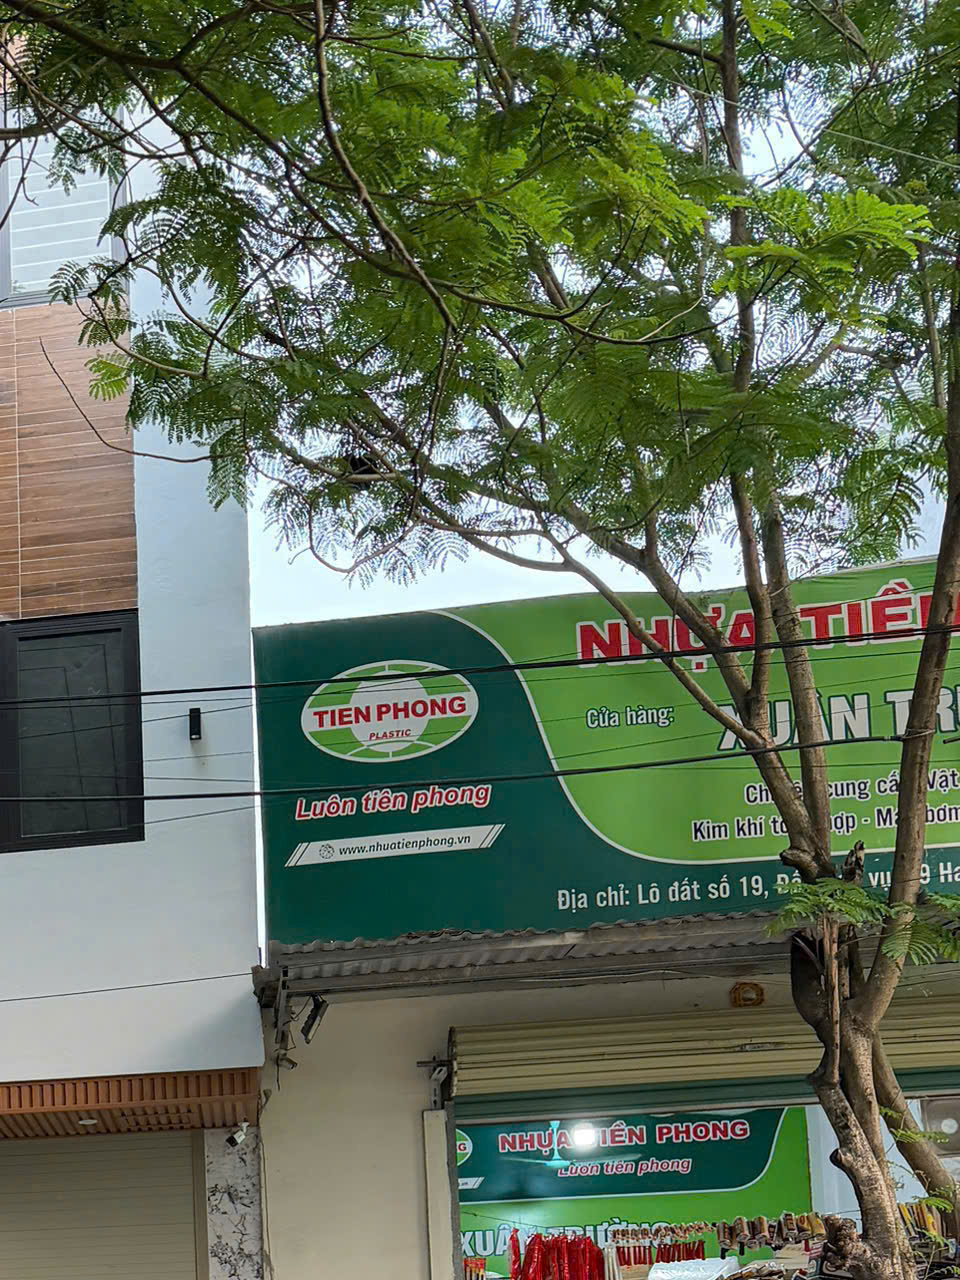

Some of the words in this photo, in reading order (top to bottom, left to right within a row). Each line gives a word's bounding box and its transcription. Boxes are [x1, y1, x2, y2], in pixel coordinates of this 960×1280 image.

[312, 706, 371, 728] TIEN
[376, 695, 467, 721] PHONG
[585, 705, 620, 729] Cửa
[625, 705, 675, 728] hàng:
[368, 728, 412, 741] PLASTIC
[295, 793, 356, 820] Luôn
[361, 788, 407, 813] tiên
[411, 783, 492, 813] phong
[692, 819, 728, 842] Kim
[735, 815, 765, 838] khí
[338, 834, 472, 856] www.nhuatienphong.vn
[556, 888, 590, 914] Địa
[596, 882, 630, 907] chỉ:
[638, 882, 661, 905] Lô
[668, 876, 701, 903] đất
[708, 872, 731, 899] số
[739, 875, 769, 899] 19,
[656, 1118, 751, 1144] PHONG
[637, 1157, 692, 1177] phong
